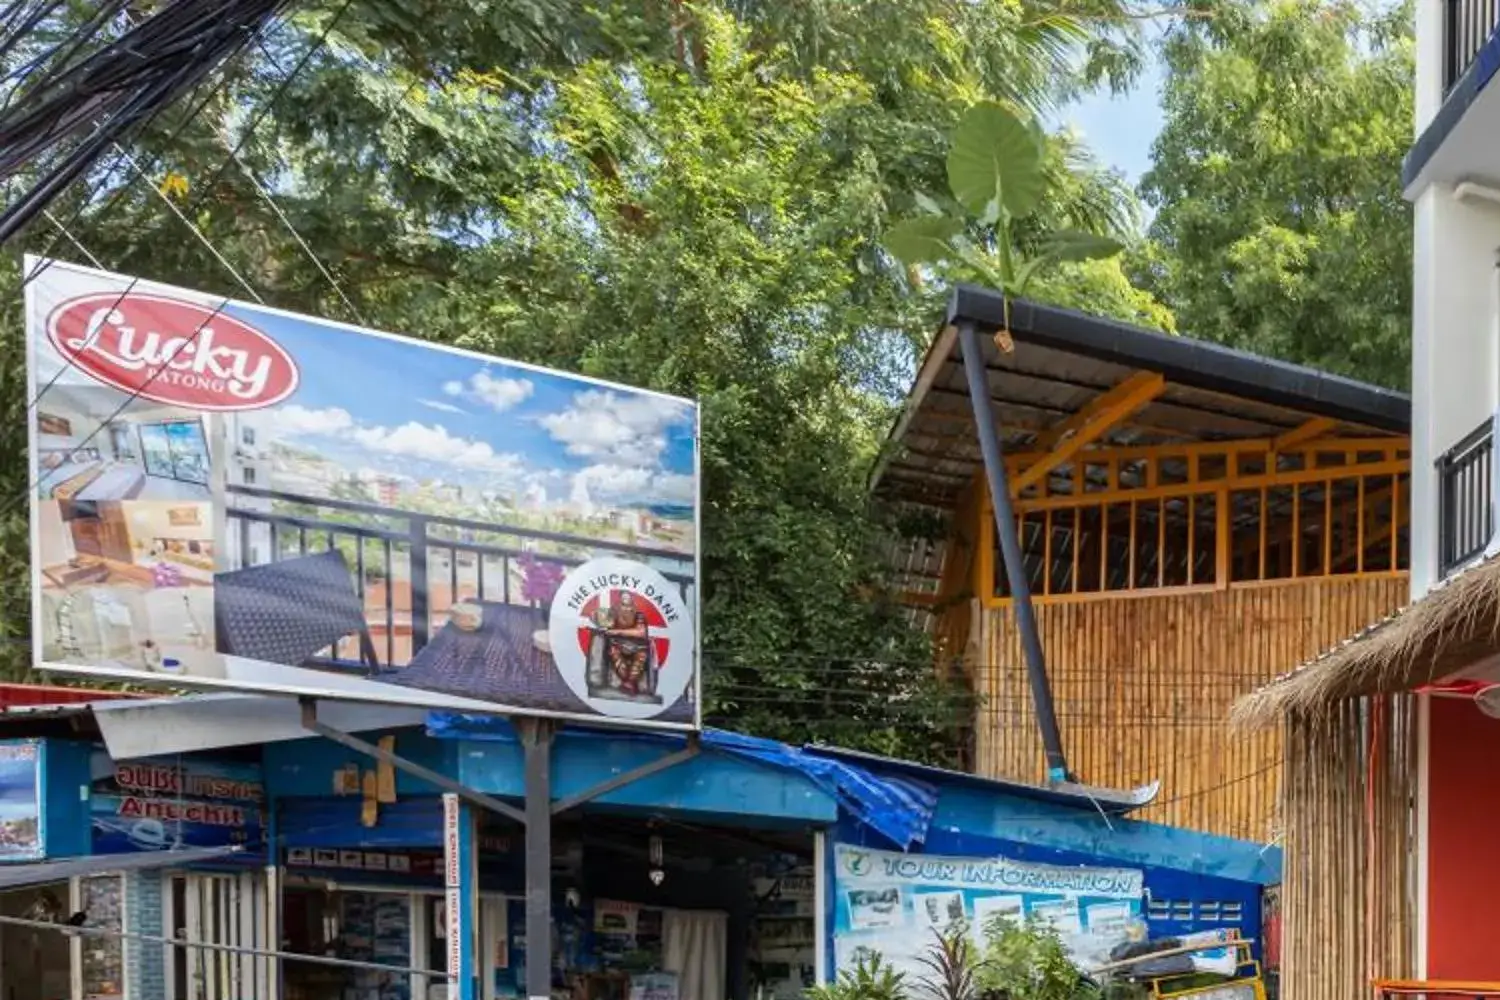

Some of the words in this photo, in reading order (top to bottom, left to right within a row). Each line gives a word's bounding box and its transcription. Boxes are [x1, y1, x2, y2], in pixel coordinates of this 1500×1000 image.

[67, 306, 272, 398] Lucky
[145, 369, 225, 393] PATONG
[567, 585, 590, 609] THE
[590, 573, 641, 588] LUCKY
[645, 584, 679, 623] DANE
[118, 797, 243, 826] Anuchit
[883, 858, 955, 881] TOUR
[961, 863, 1134, 894] INFORMATION
